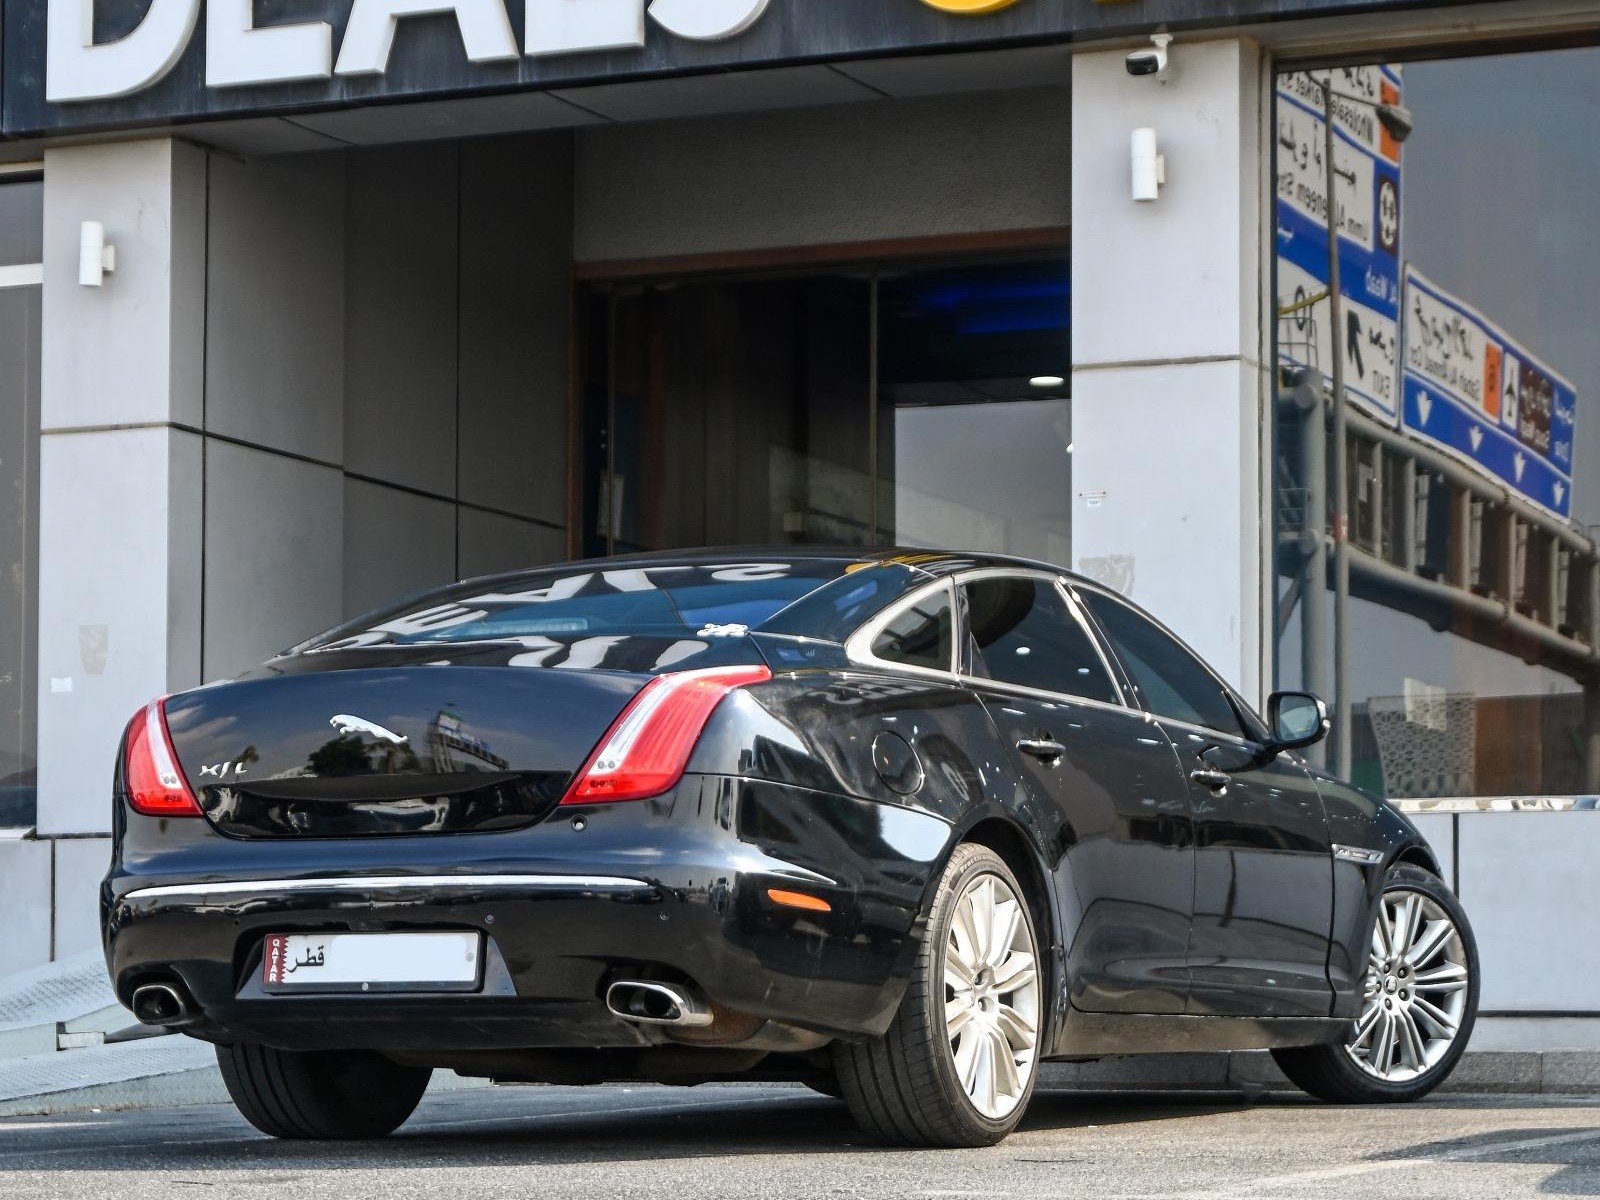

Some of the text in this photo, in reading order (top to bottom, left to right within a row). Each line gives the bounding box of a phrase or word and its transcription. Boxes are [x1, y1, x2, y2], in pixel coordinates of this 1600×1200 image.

[198, 760, 248, 779] XJL
[268, 938, 281, 983] QATAR
[286, 945, 325, 973] قطر
